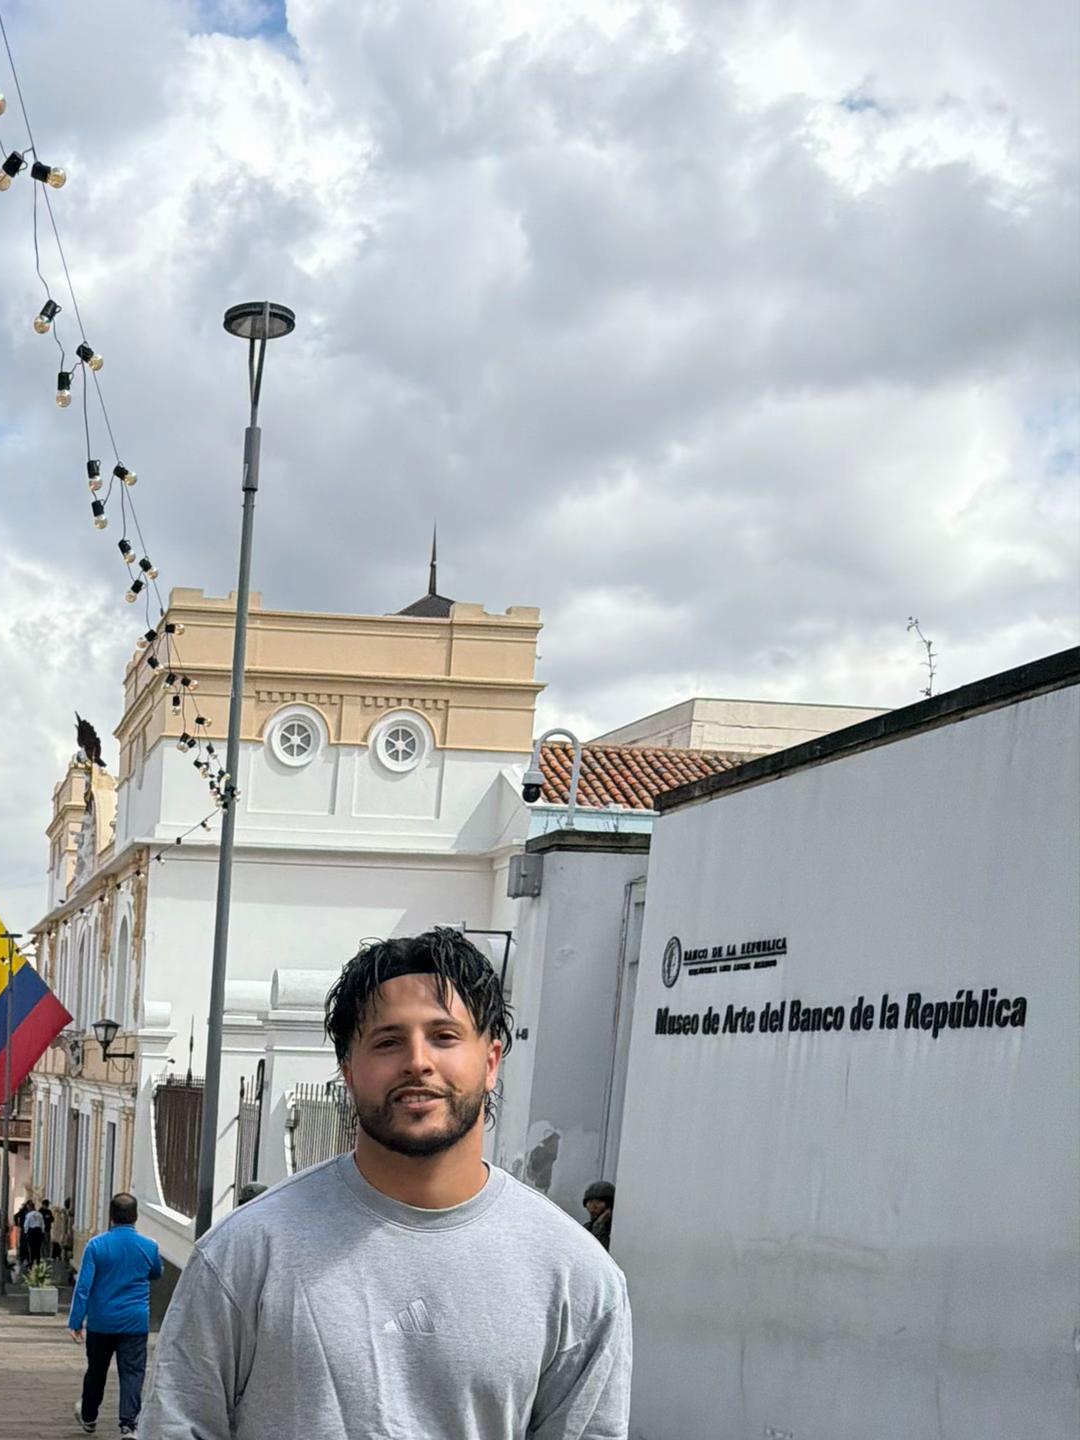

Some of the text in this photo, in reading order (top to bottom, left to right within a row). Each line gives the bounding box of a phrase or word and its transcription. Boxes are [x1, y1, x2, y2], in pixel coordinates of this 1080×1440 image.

[712, 945, 723, 958] DE
[726, 943, 737, 957] LA
[655, 987, 1028, 1040] Museo de Arte del Banco de la República
